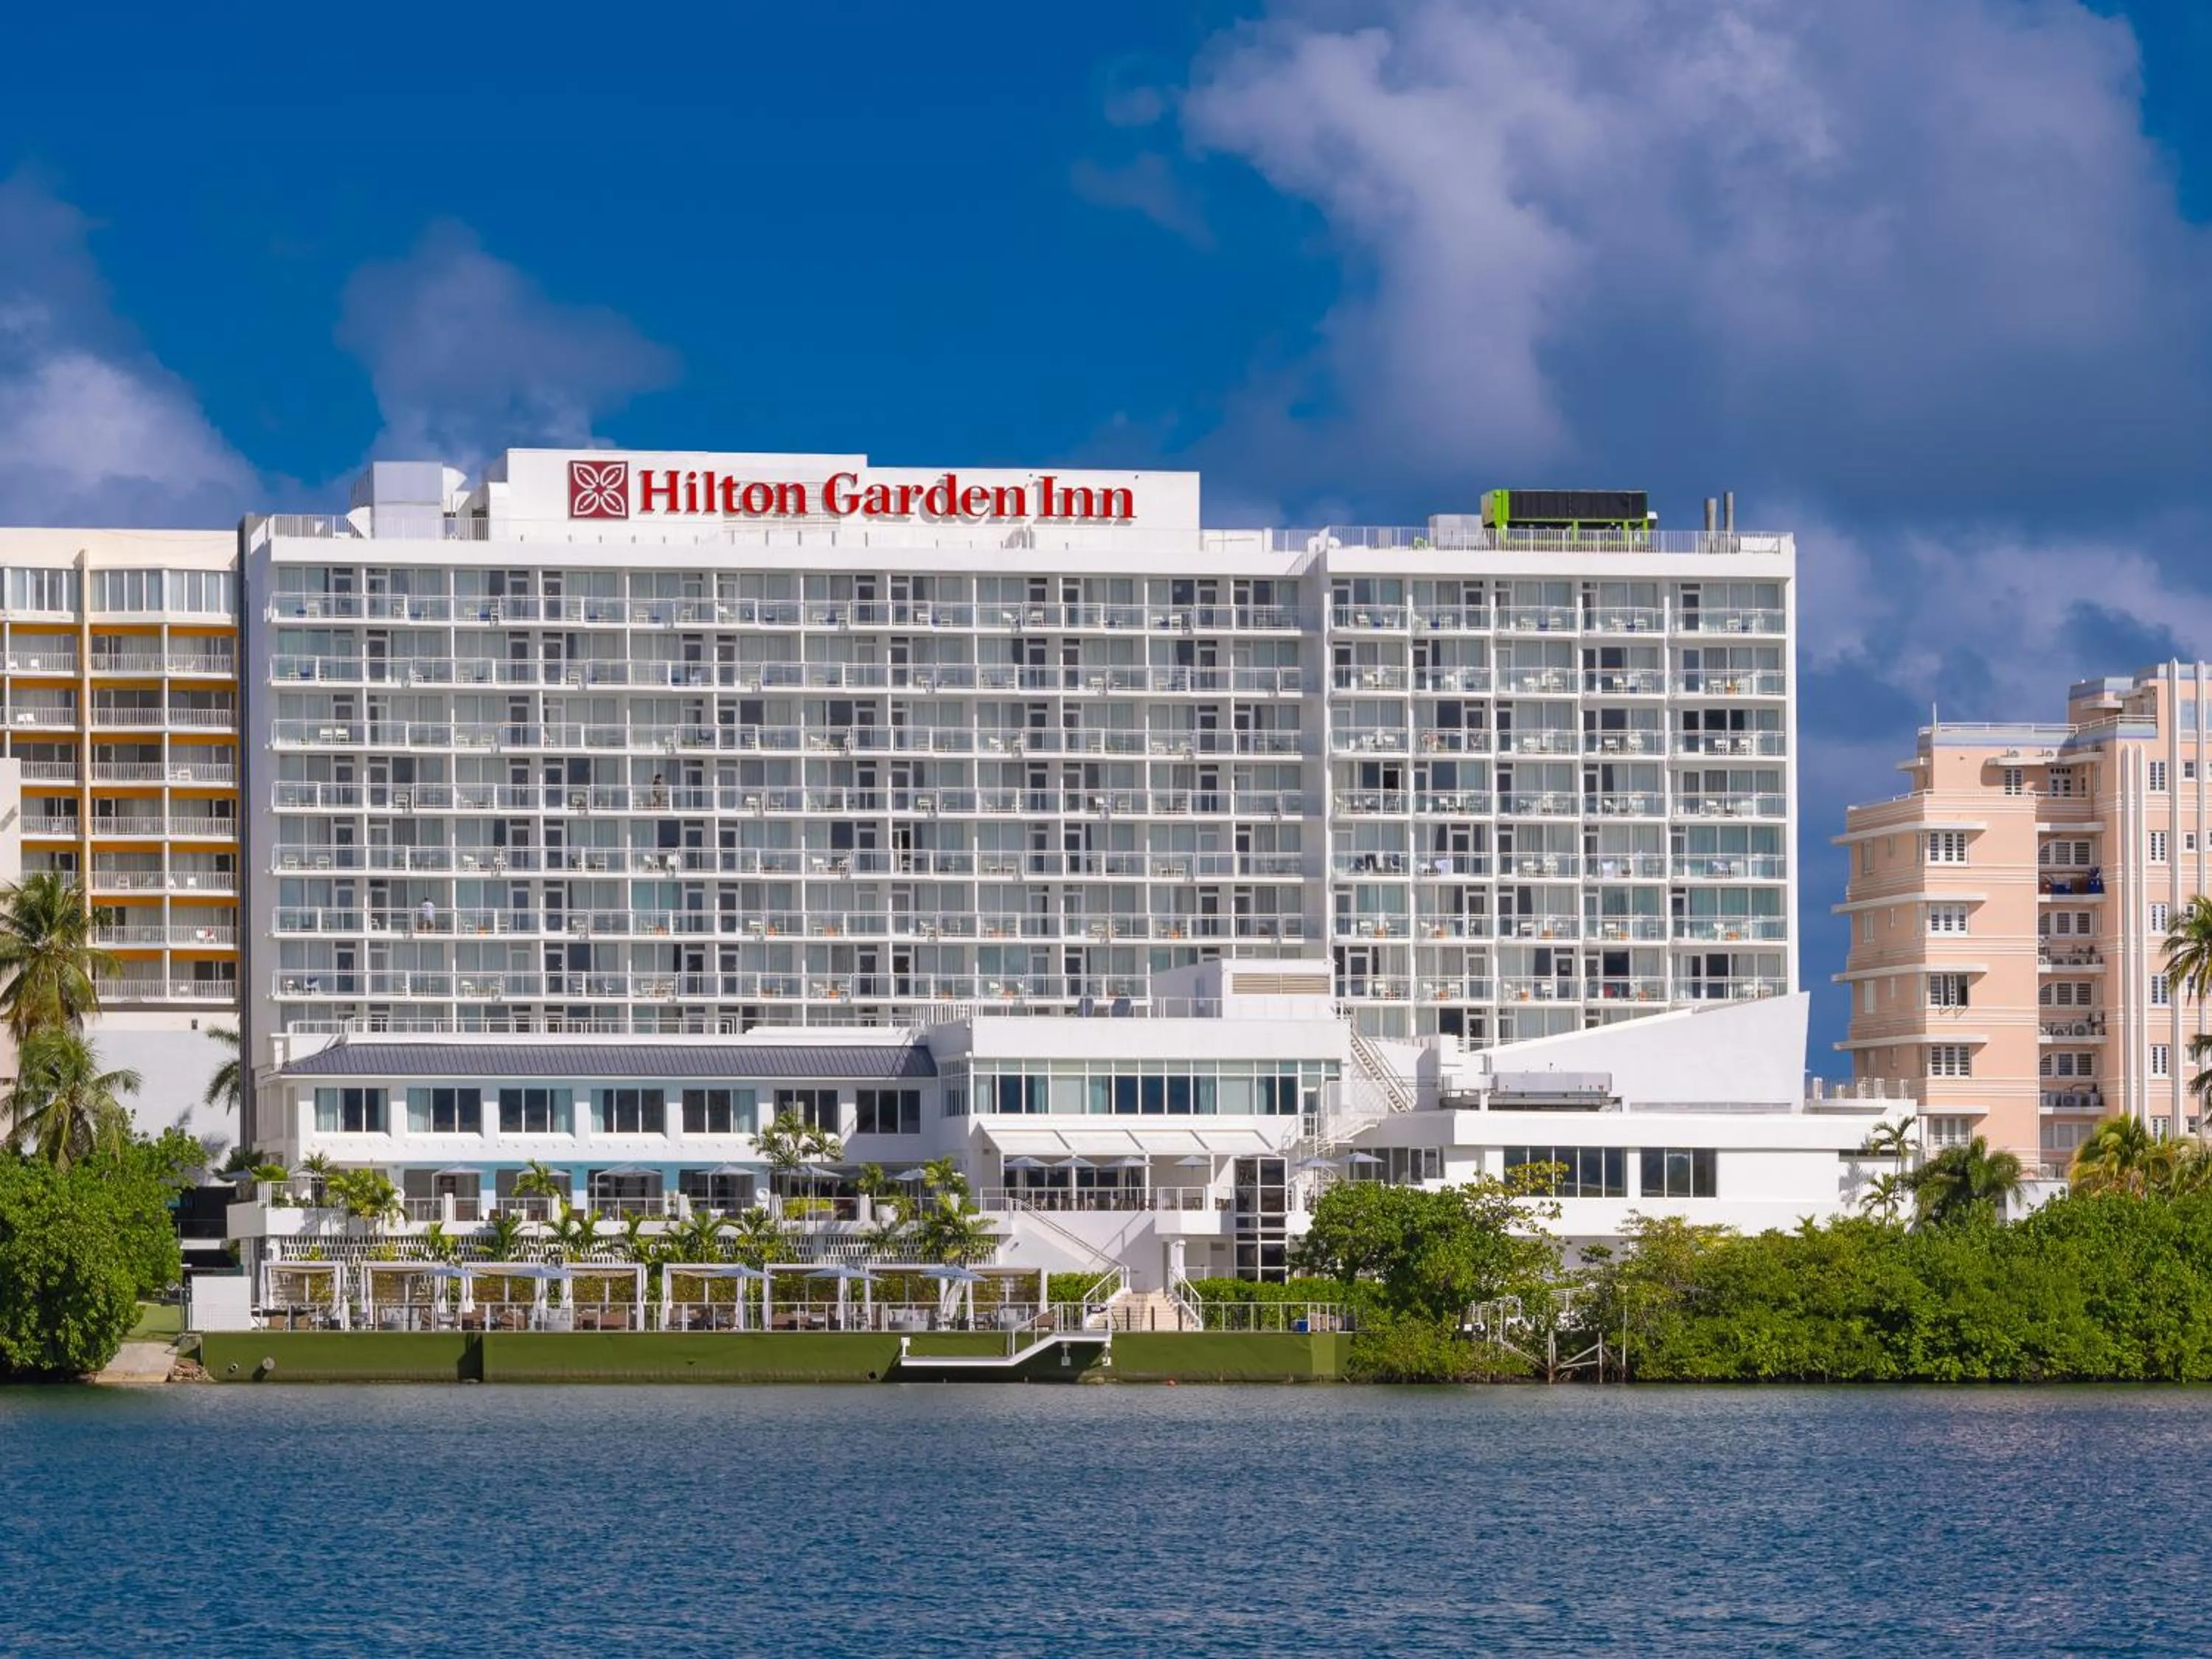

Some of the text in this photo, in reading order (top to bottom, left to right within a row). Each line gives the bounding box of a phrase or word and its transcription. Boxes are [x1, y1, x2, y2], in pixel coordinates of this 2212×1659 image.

[640, 469, 1136, 521] Hilton Garden Inn
